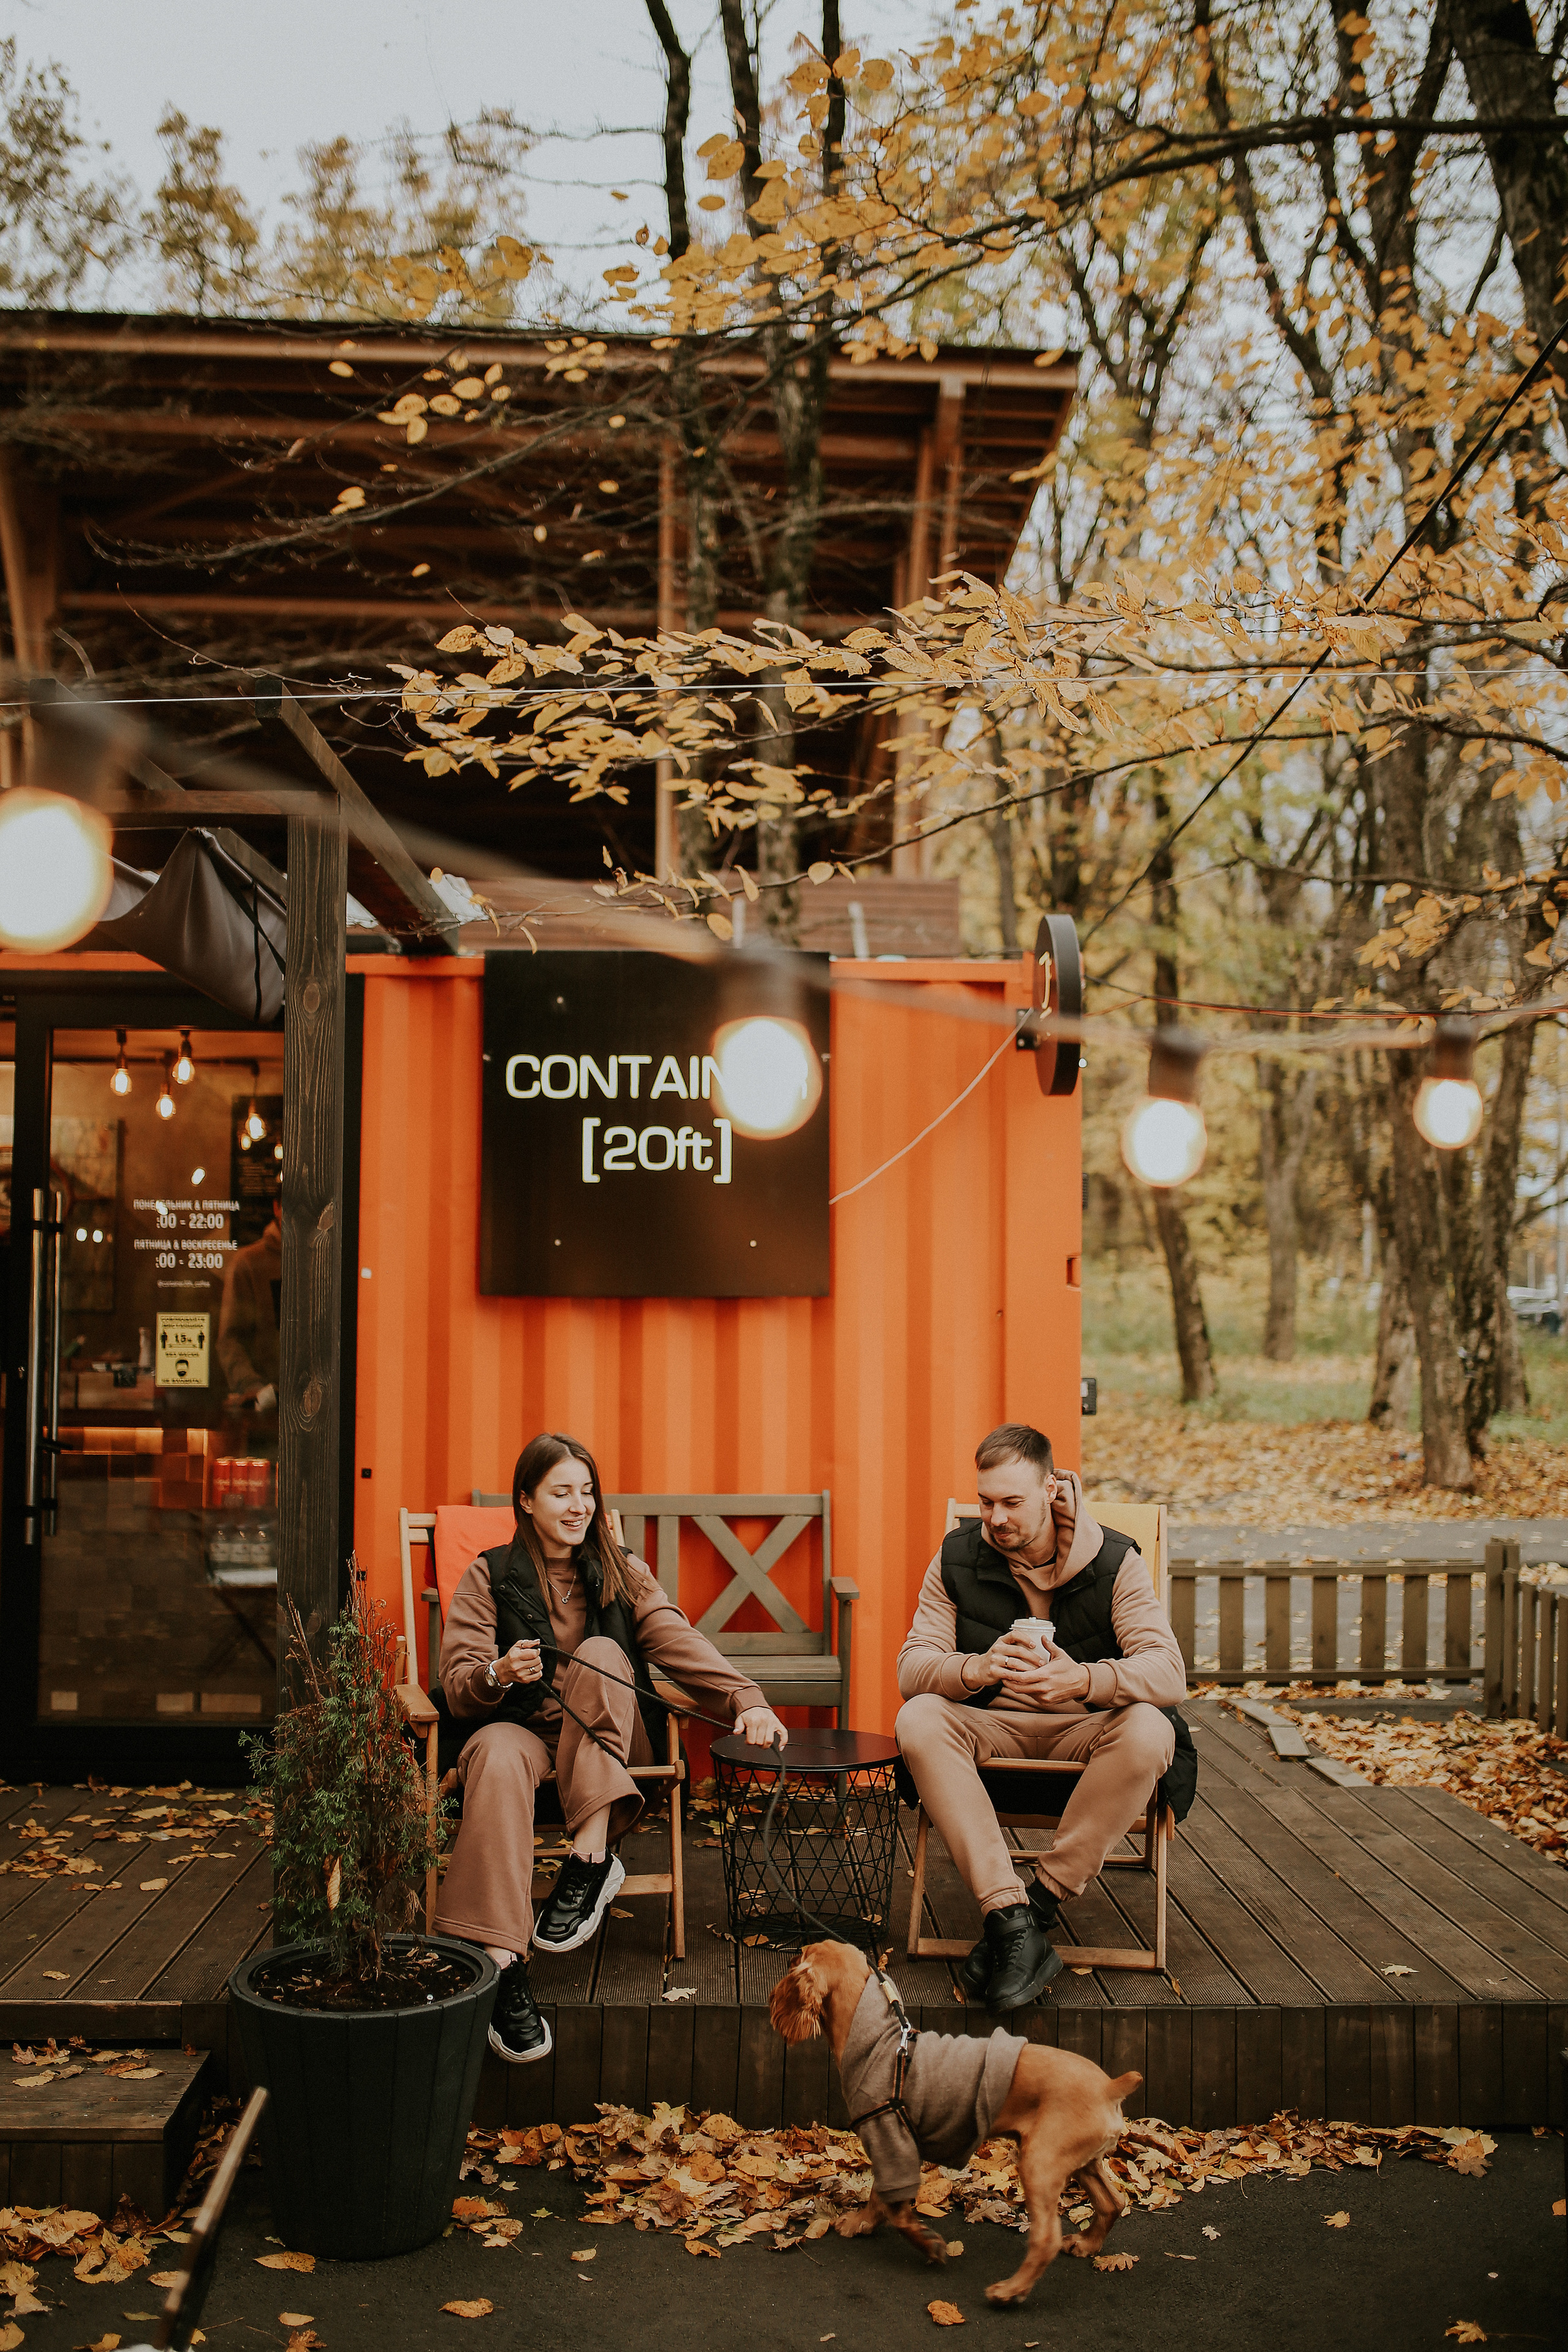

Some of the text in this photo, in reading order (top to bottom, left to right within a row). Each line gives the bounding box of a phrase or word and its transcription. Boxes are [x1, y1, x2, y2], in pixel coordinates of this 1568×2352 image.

[505, 1054, 809, 1099] CONTAIN
[189, 1213, 224, 1229] 22:00
[134, 1239, 172, 1250] ПЯТНИЦА
[181, 1240, 238, 1251] ВОСКРЕСЕНЬЕ
[188, 1253, 224, 1268] 23:00
